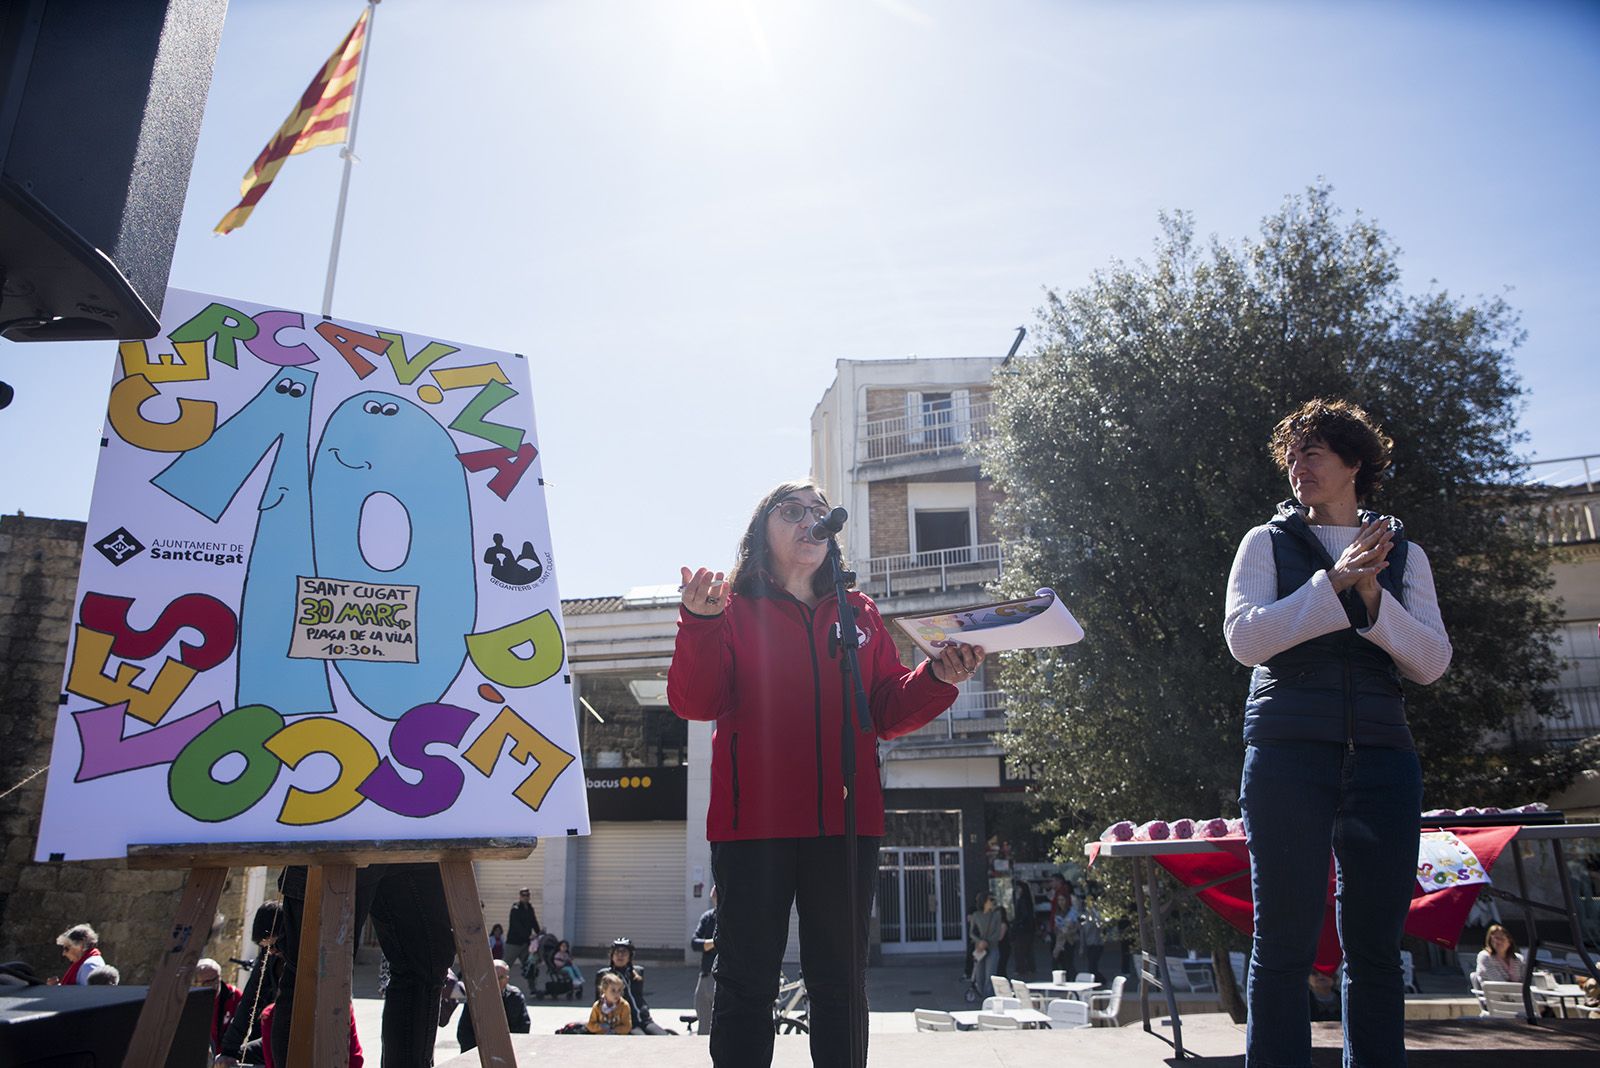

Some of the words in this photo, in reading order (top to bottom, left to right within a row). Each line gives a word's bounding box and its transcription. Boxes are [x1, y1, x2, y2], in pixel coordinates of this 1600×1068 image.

[152, 538, 227, 551] AJUNTAMENT
[230, 543, 244, 553] DE
[150, 548, 243, 565] SantCugat
[304, 580, 350, 596] SANT
[353, 586, 411, 601] CUGAT
[489, 577, 532, 592] GEGANTERS
[299, 598, 334, 625] 30
[350, 630, 366, 641] DE
[369, 631, 383, 642] LA
